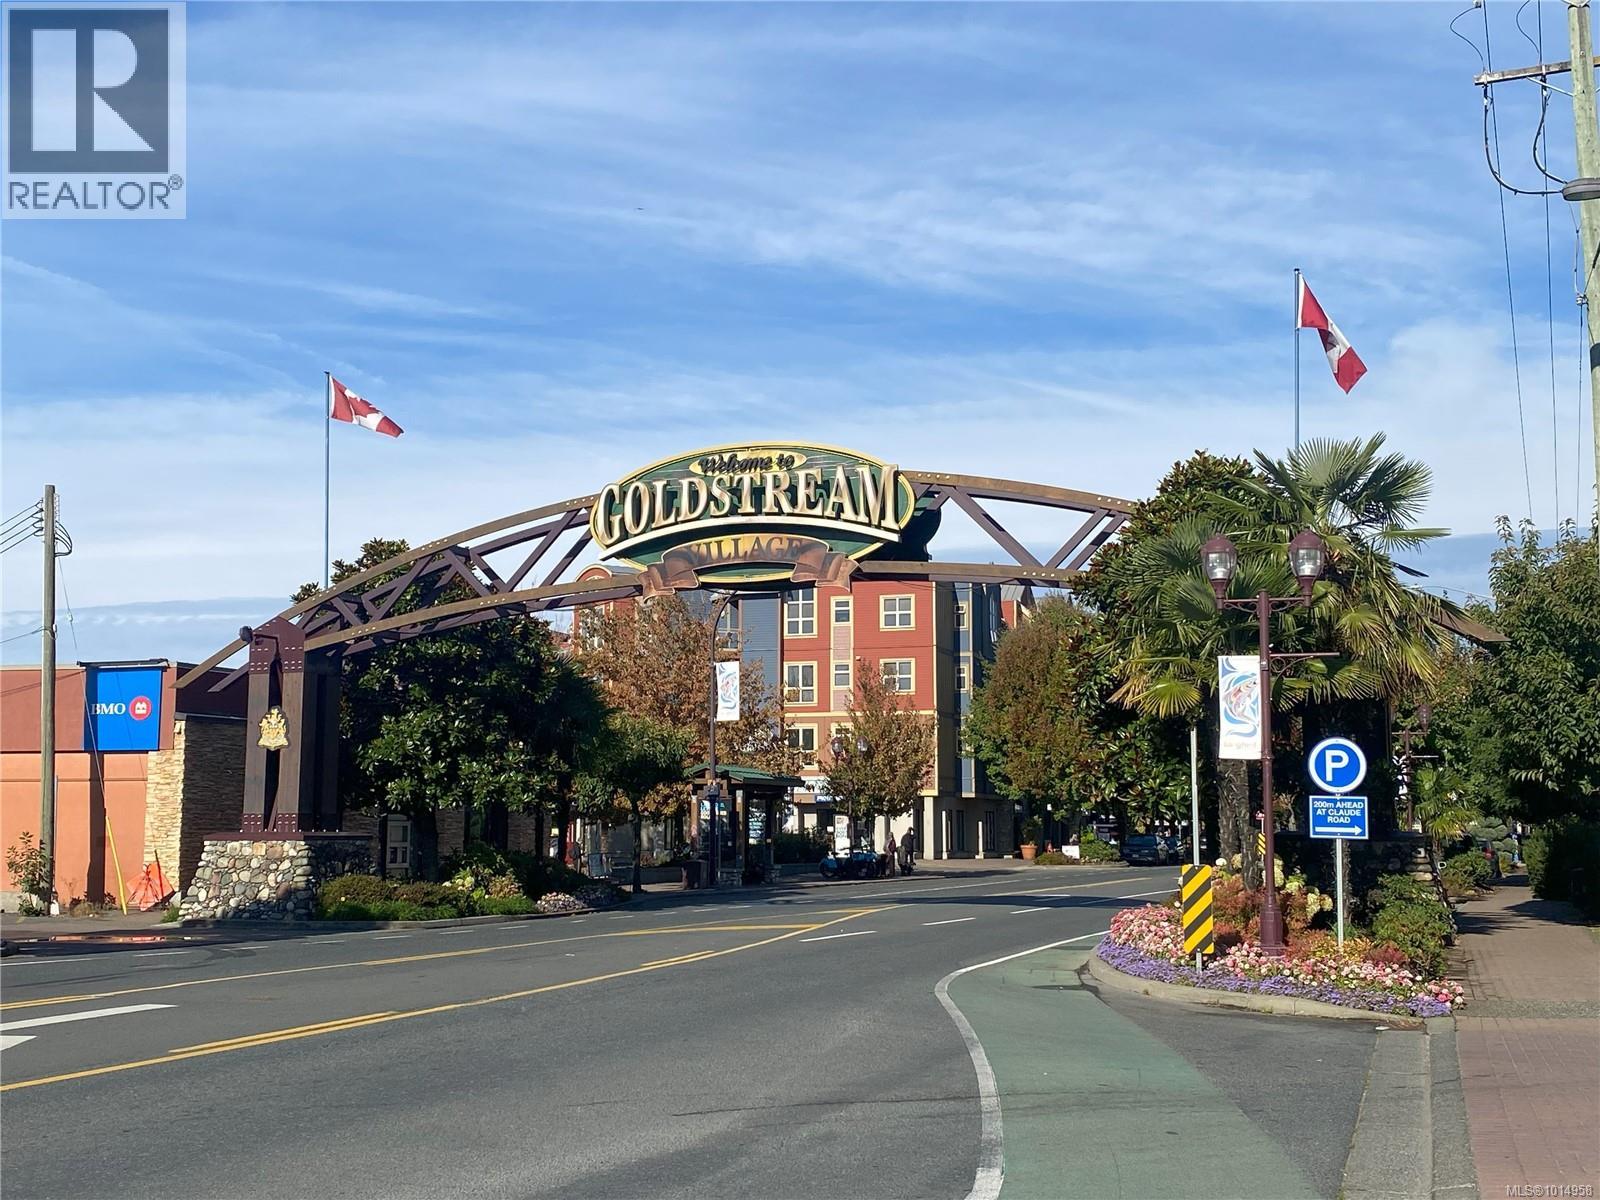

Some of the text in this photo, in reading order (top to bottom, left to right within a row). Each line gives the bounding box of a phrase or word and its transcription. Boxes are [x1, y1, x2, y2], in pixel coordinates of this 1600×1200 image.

[698, 453, 795, 474] Welcome to
[597, 464, 901, 546] GOLDSTREAM
[687, 536, 803, 565] VILLAGE
[91, 702, 126, 715] BMO
[1325, 749, 1349, 782] P
[1316, 808, 1361, 816] AT CLAUDE
[1336, 801, 1364, 809] AHEAD
